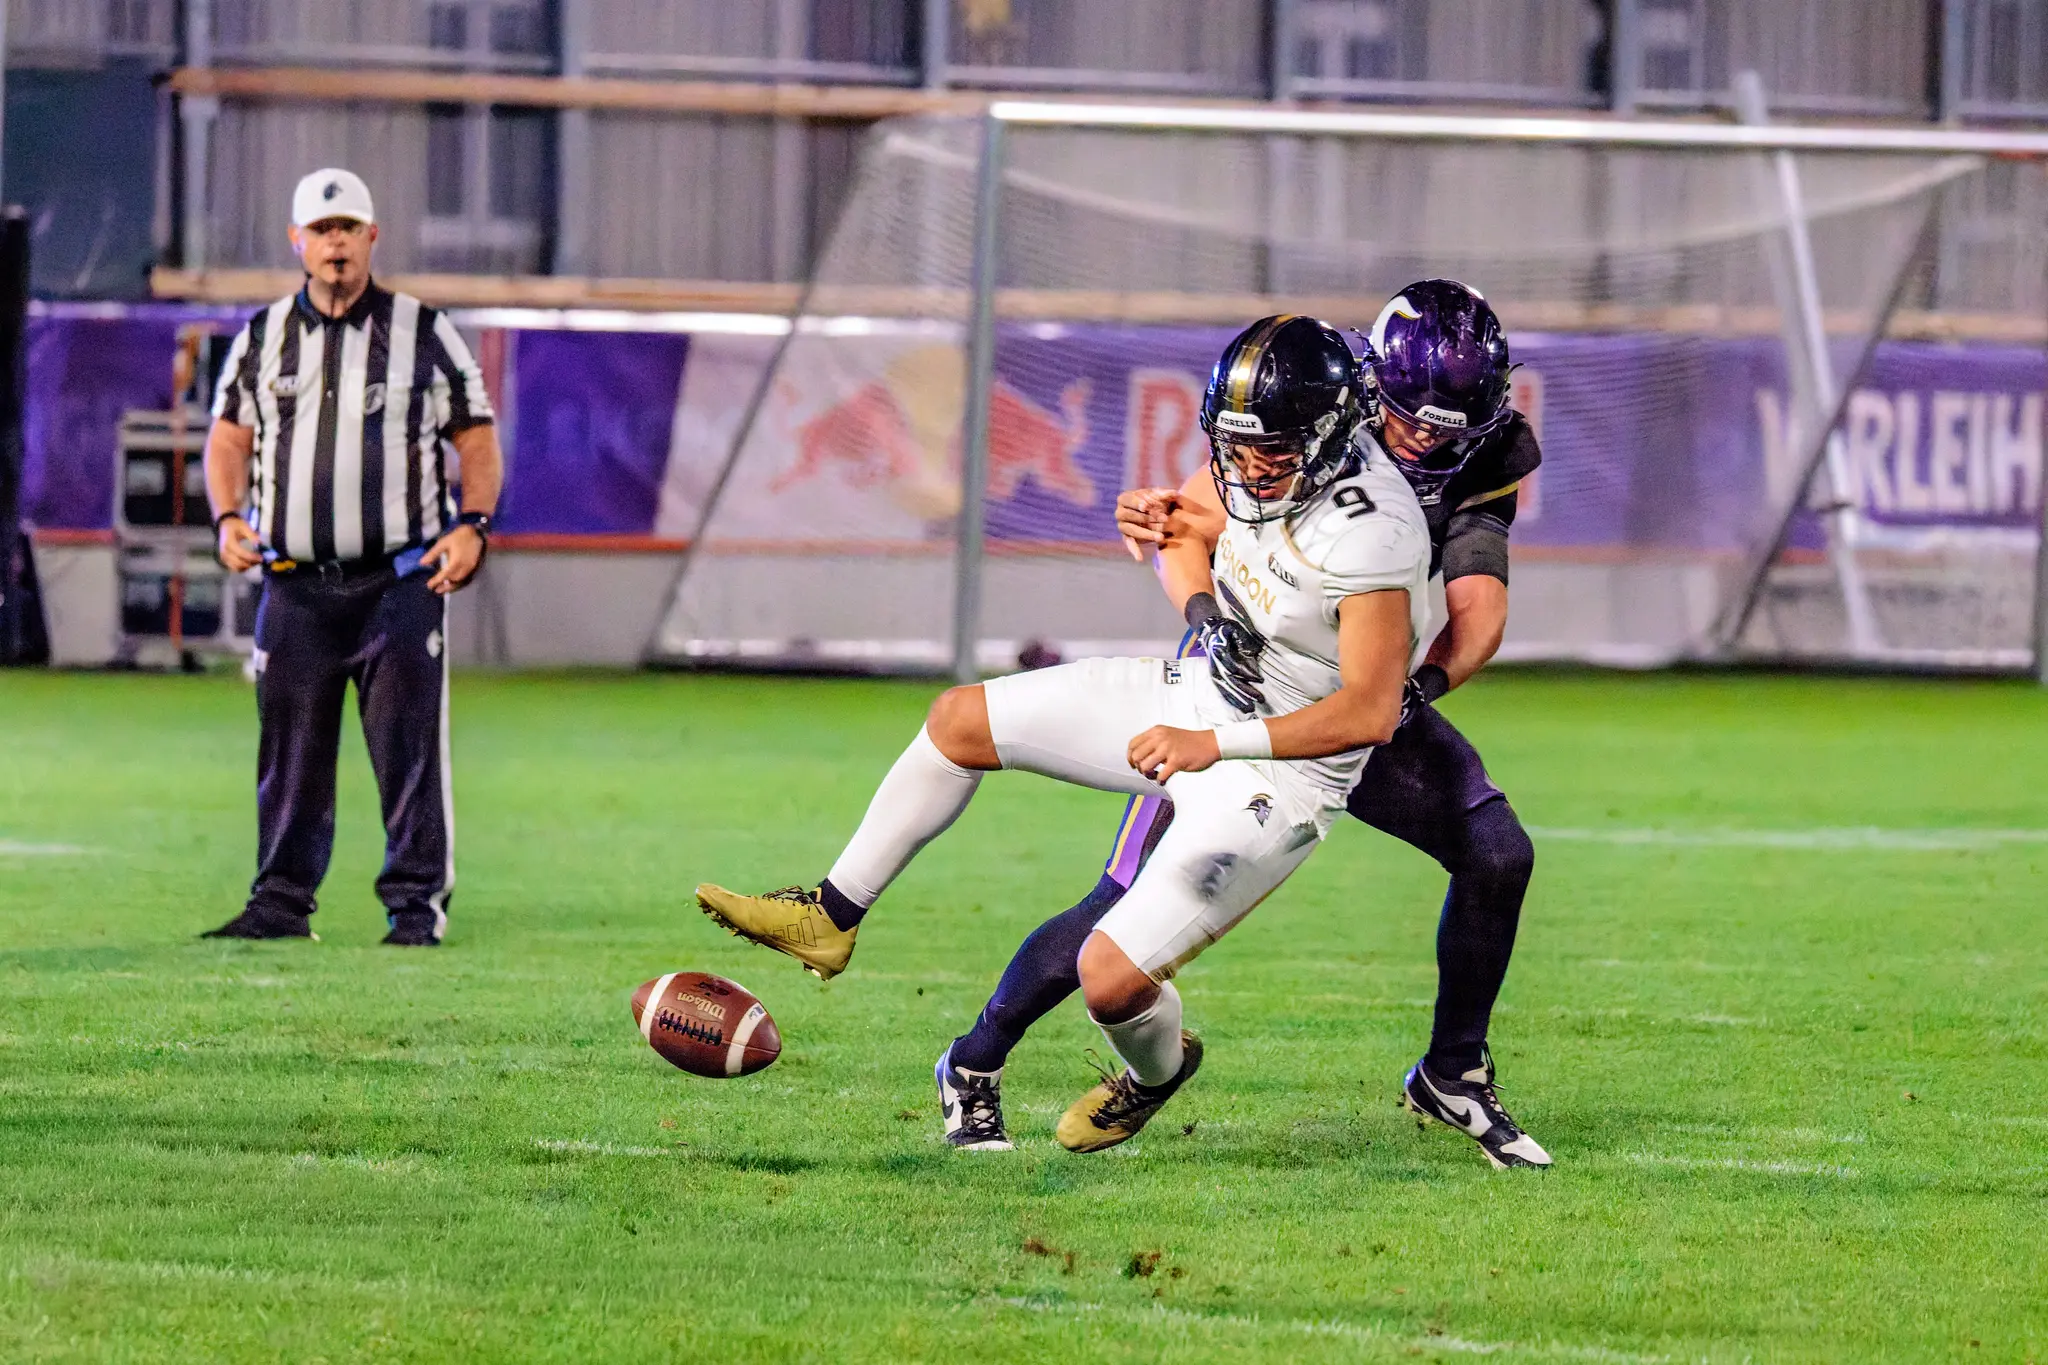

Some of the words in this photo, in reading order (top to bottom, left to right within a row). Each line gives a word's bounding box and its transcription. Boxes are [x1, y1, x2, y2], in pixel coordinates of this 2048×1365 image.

[1220, 416, 1257, 429] FORELLE
[1422, 410, 1464, 425] FORELLE
[1754, 387, 2042, 514] VRLEIH
[1331, 486, 1378, 520] 9
[676, 992, 726, 1020] Wilson
